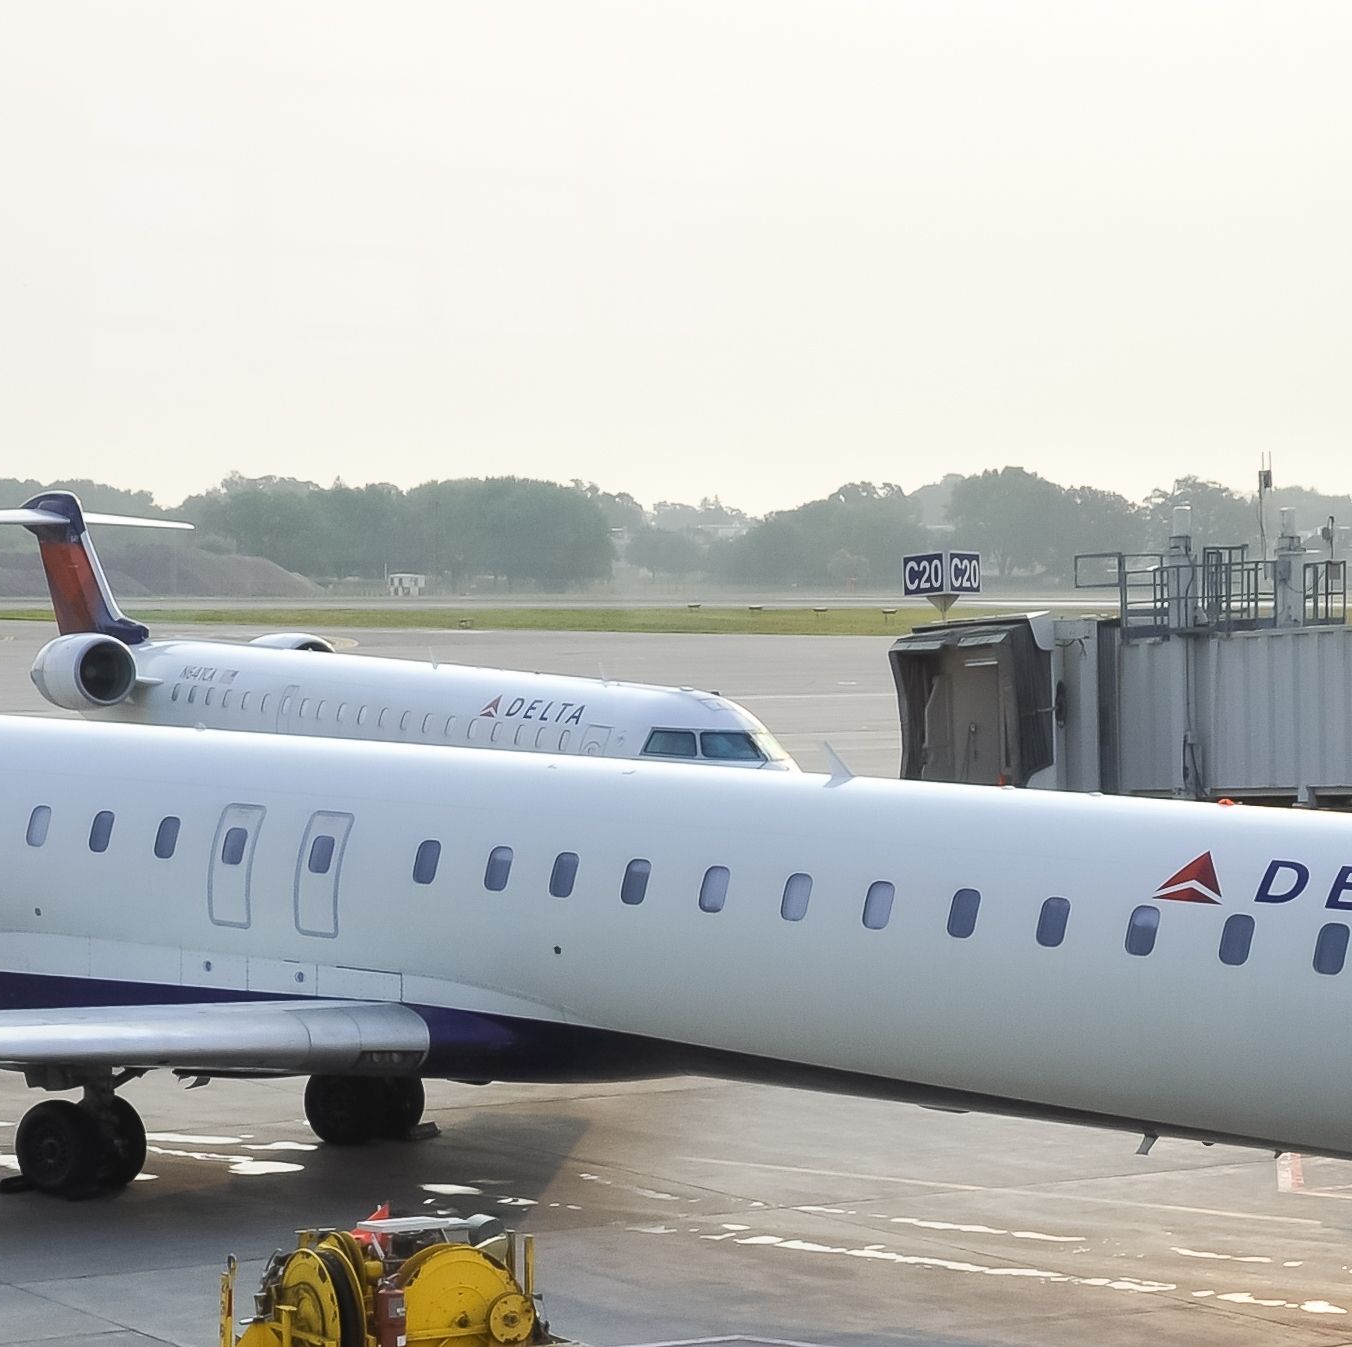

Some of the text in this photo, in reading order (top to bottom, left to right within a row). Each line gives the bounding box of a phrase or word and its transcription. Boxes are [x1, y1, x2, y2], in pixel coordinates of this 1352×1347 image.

[905, 559, 942, 590] C20
[950, 557, 979, 588] C20
[505, 697, 586, 725] DELTA
